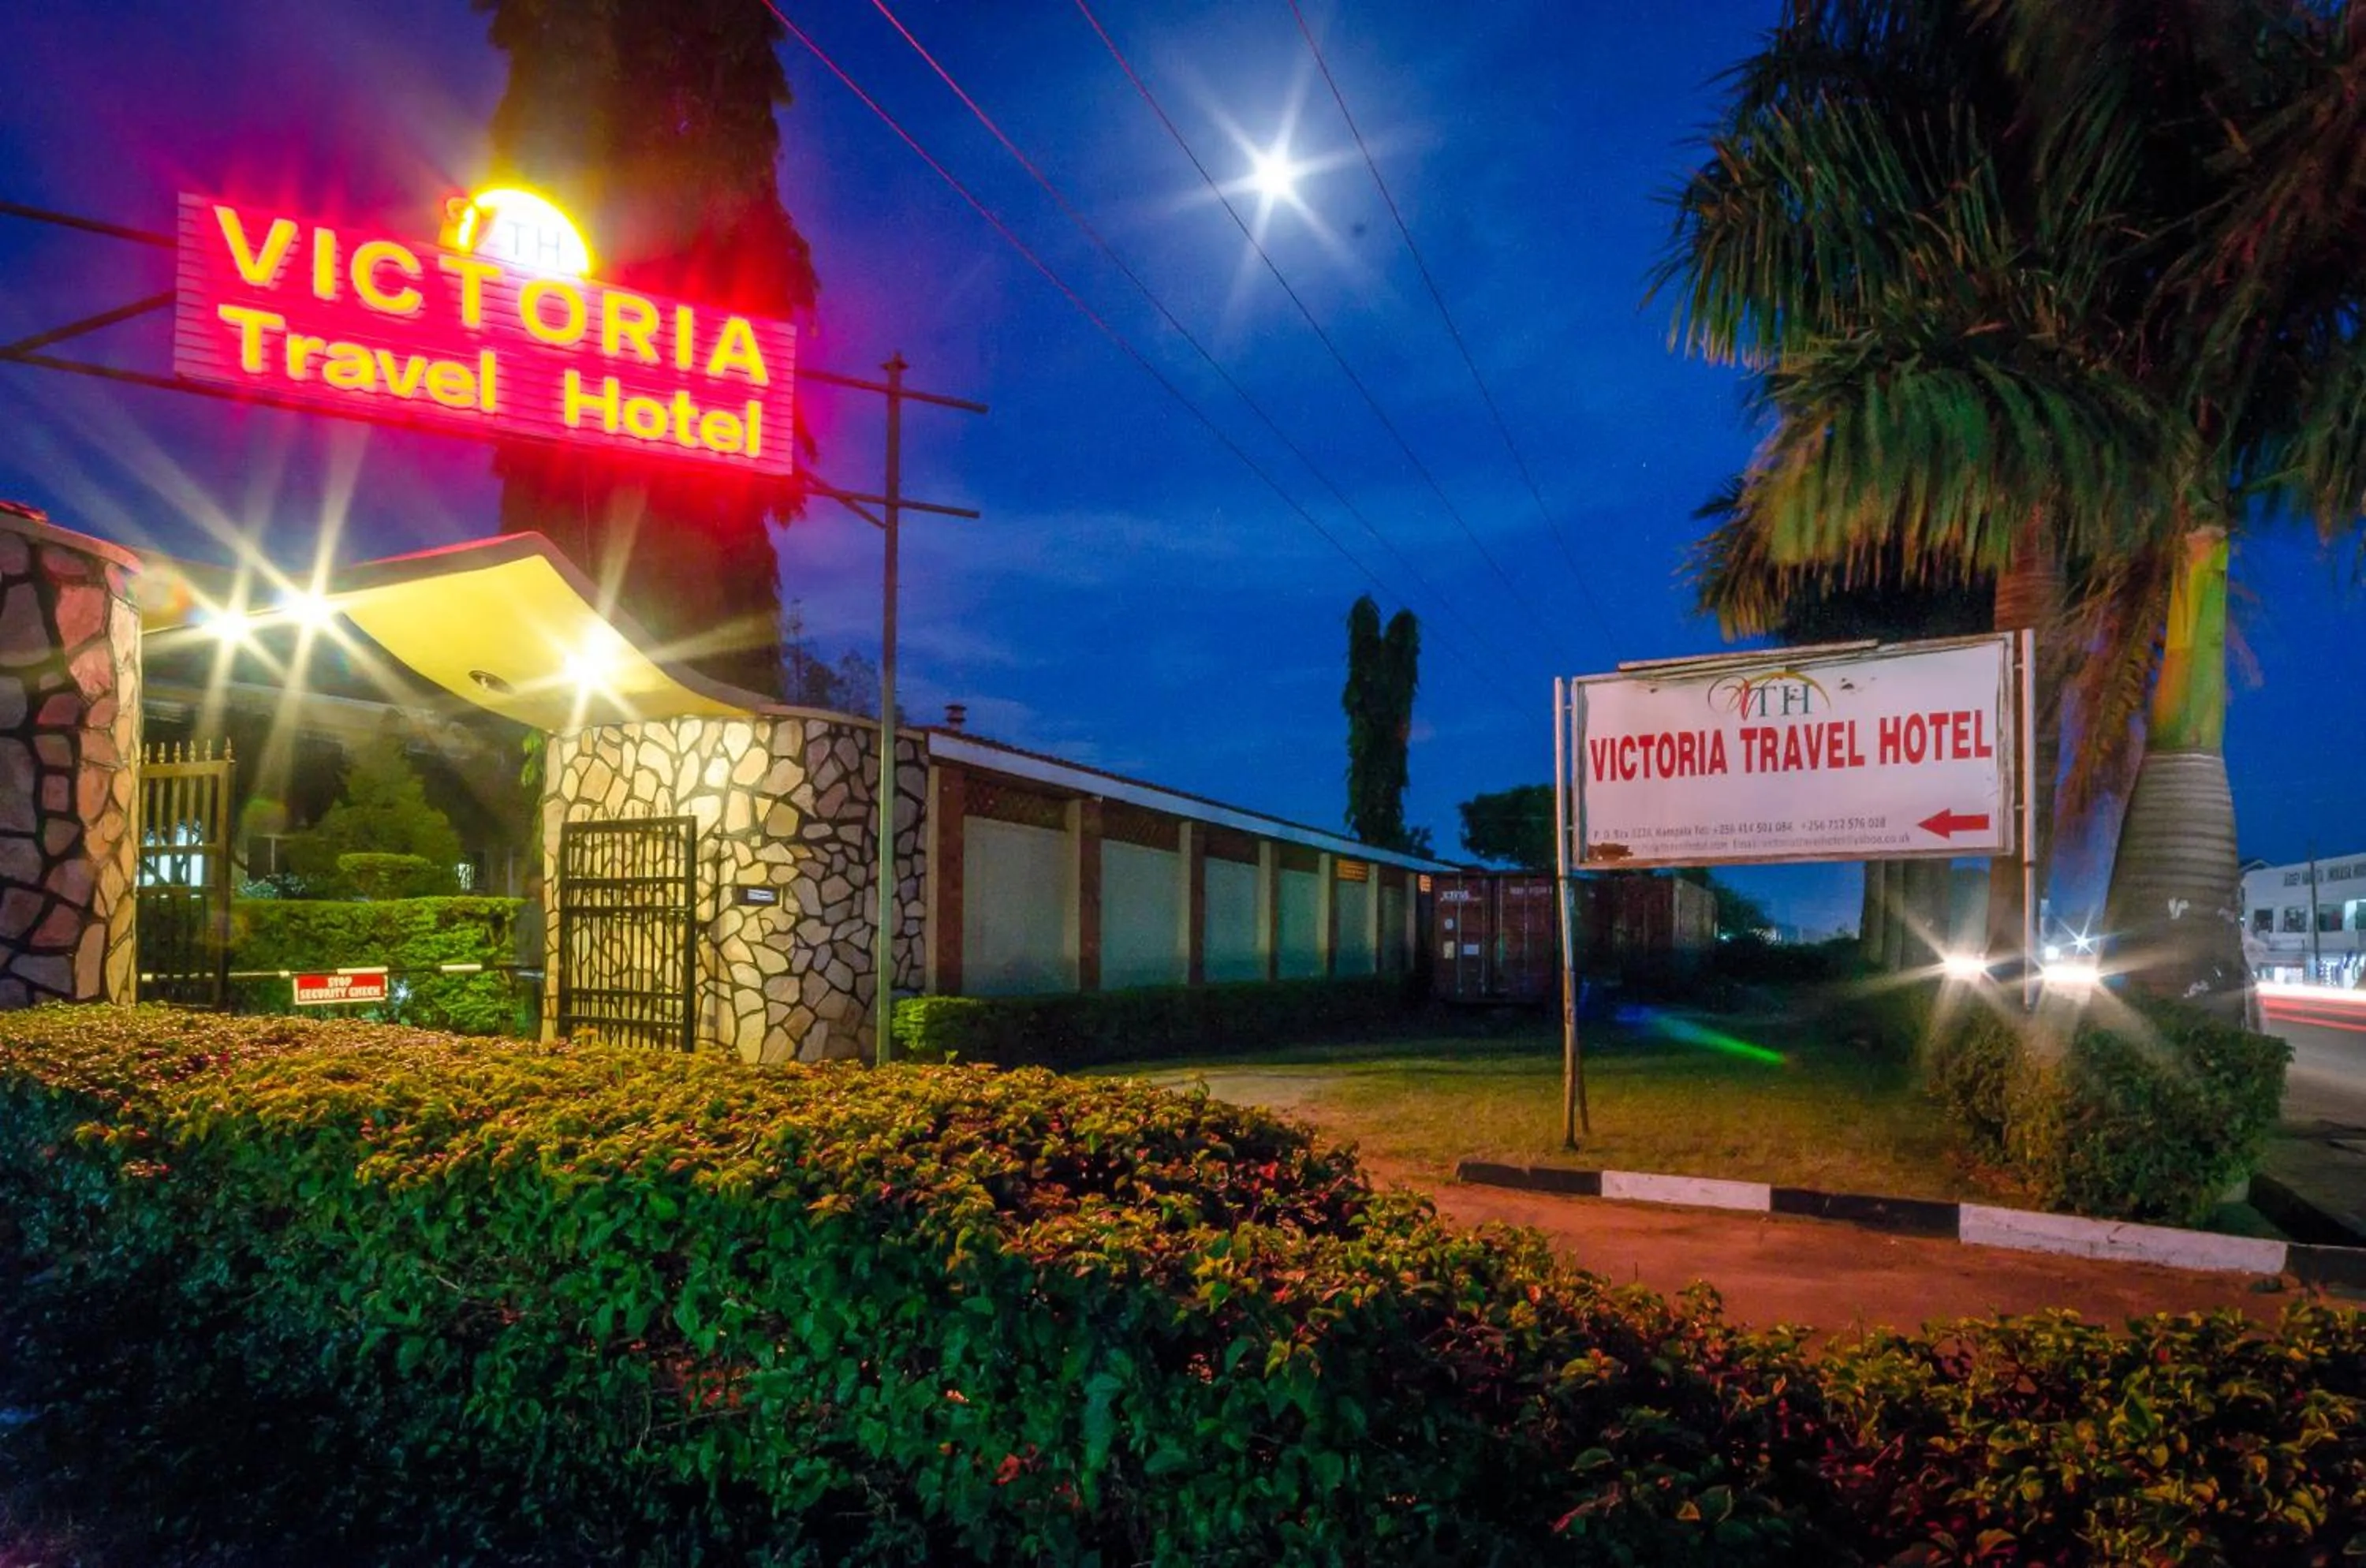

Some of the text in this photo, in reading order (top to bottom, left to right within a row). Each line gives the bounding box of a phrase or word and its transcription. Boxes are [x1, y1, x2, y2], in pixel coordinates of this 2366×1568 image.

[214, 205, 770, 386] VICTORIA
[218, 303, 762, 457] Travel Hotel
[1590, 709, 1992, 782] VICTORIA TRAVEL HOTEL
[299, 985, 381, 1000] SECURITY CHECK
[327, 976, 353, 987] STOP
